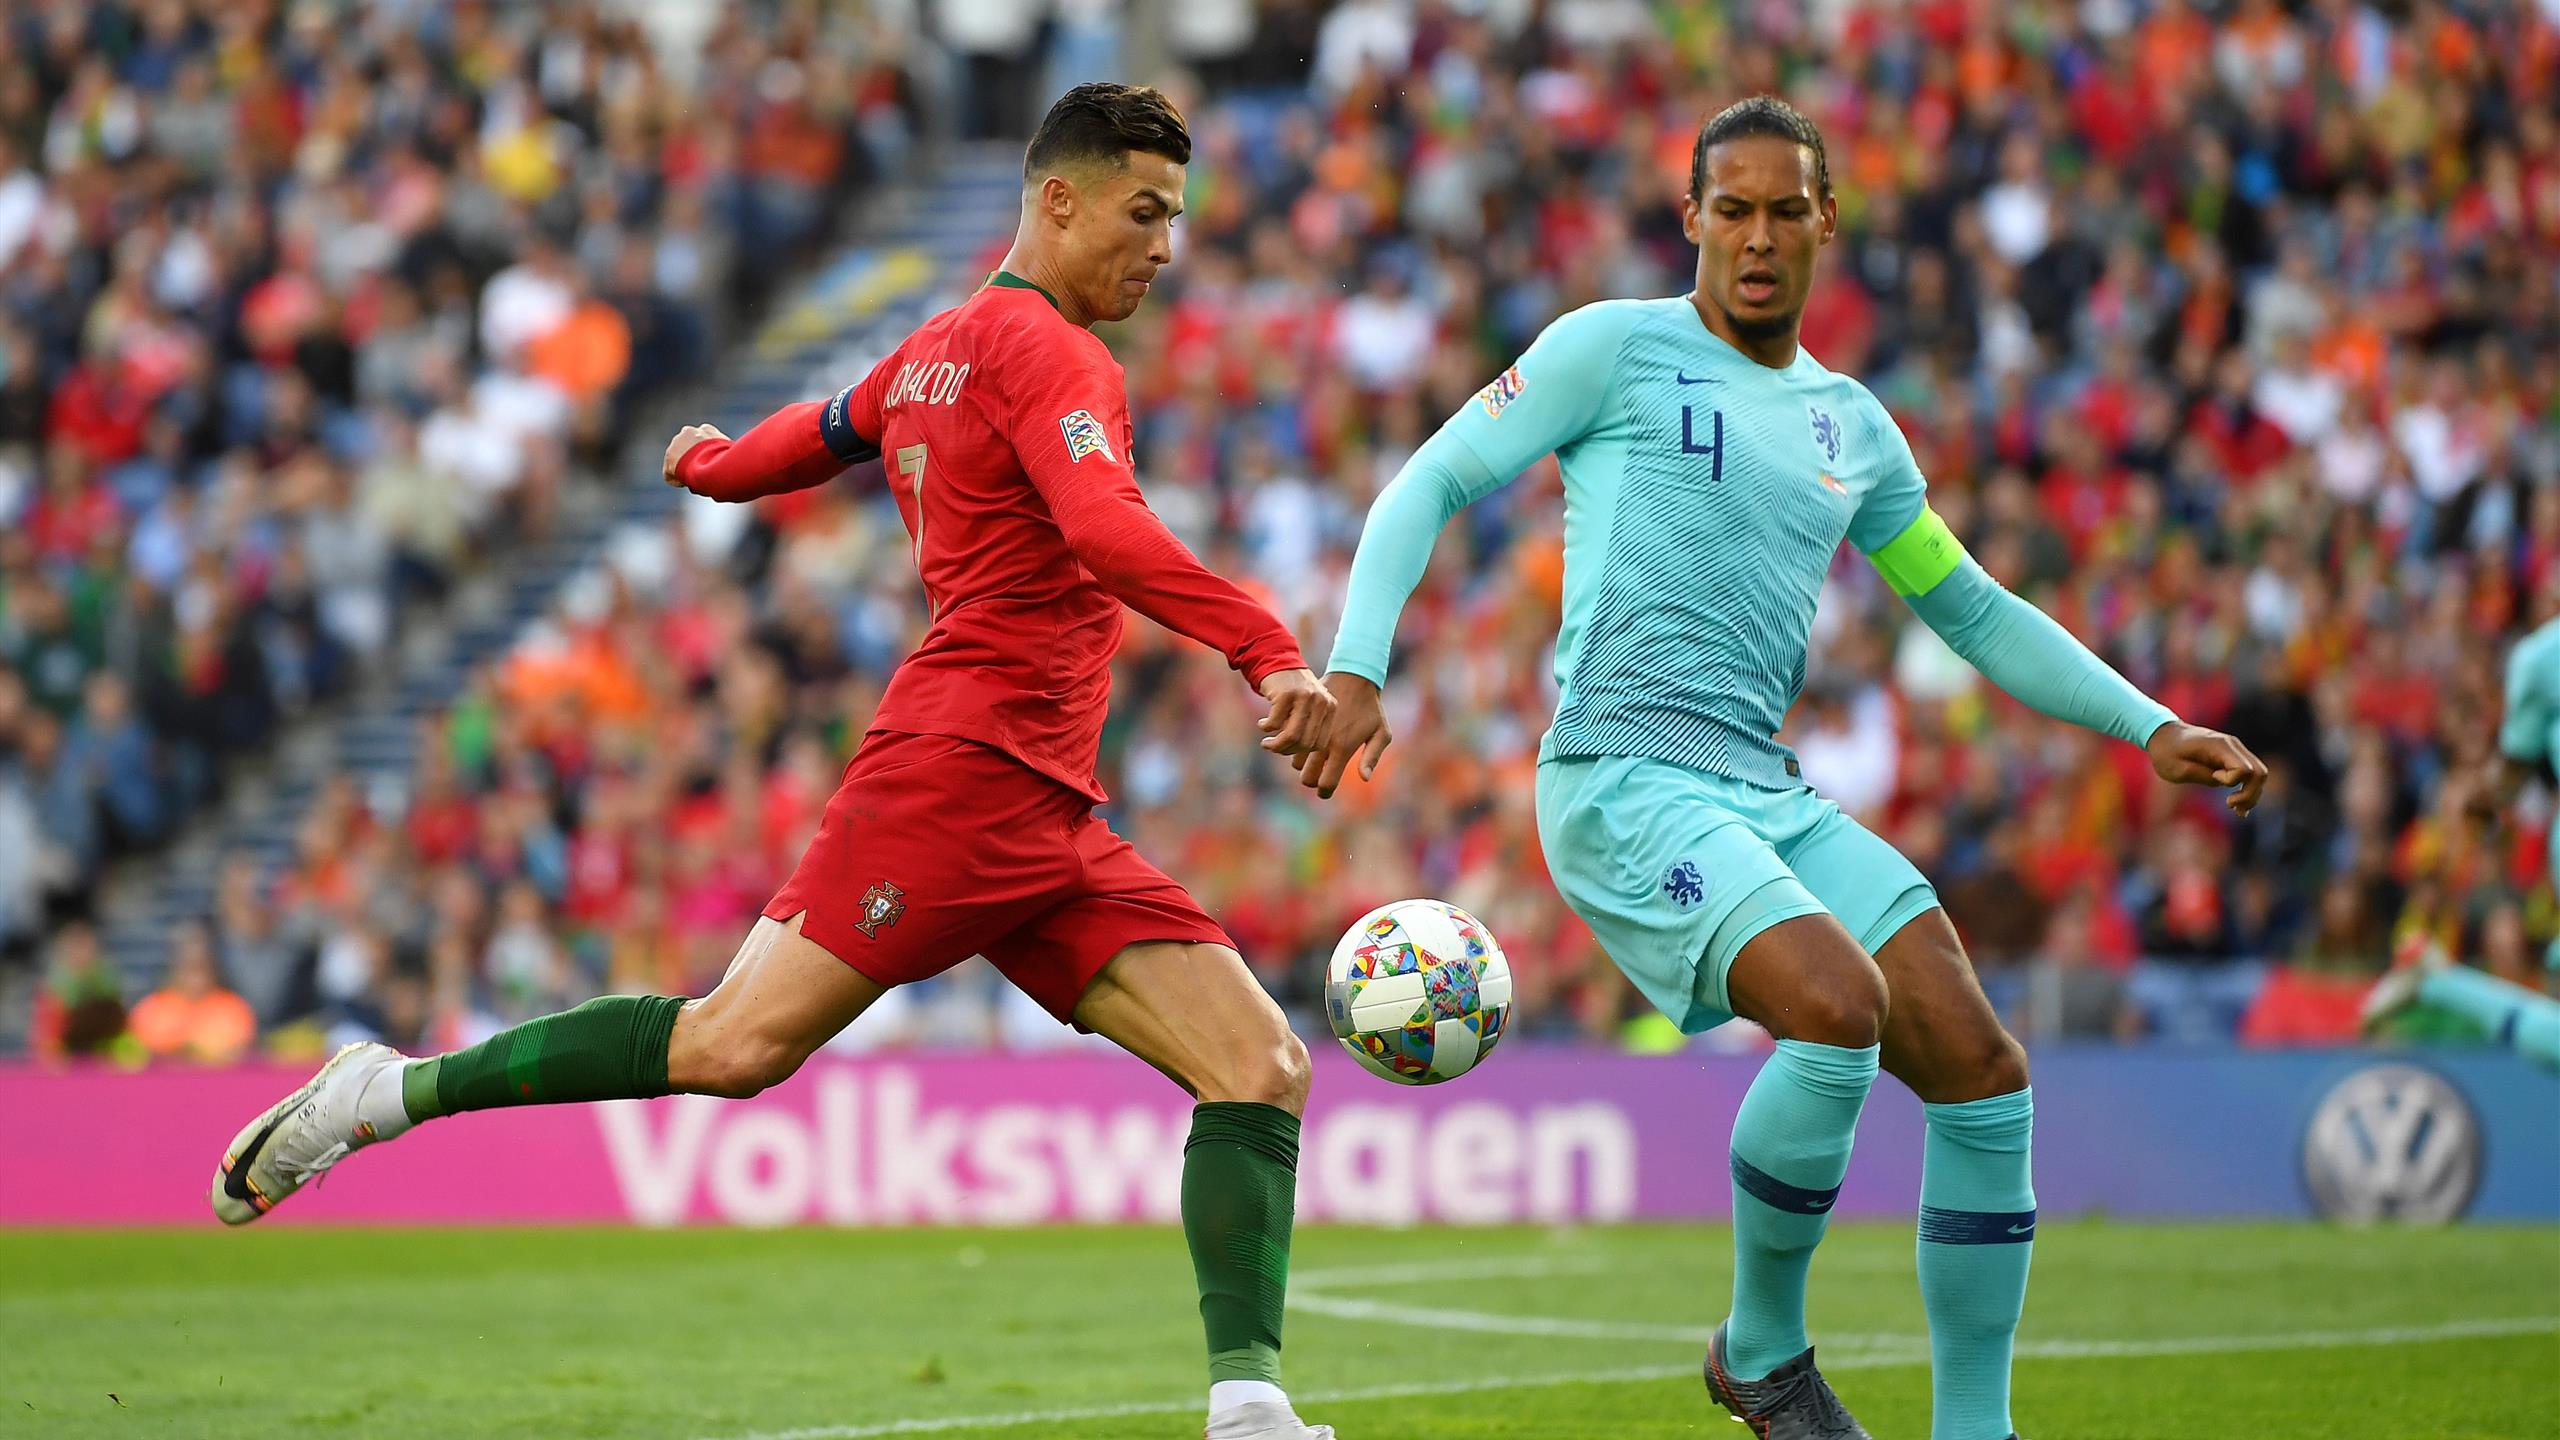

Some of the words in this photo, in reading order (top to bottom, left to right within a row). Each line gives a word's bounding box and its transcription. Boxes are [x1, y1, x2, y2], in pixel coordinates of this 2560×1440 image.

[885, 359, 970, 409] ONALDO
[1681, 404, 1723, 482] 4
[896, 443, 934, 592] 7
[592, 1070, 1638, 1228] Volkswgen
